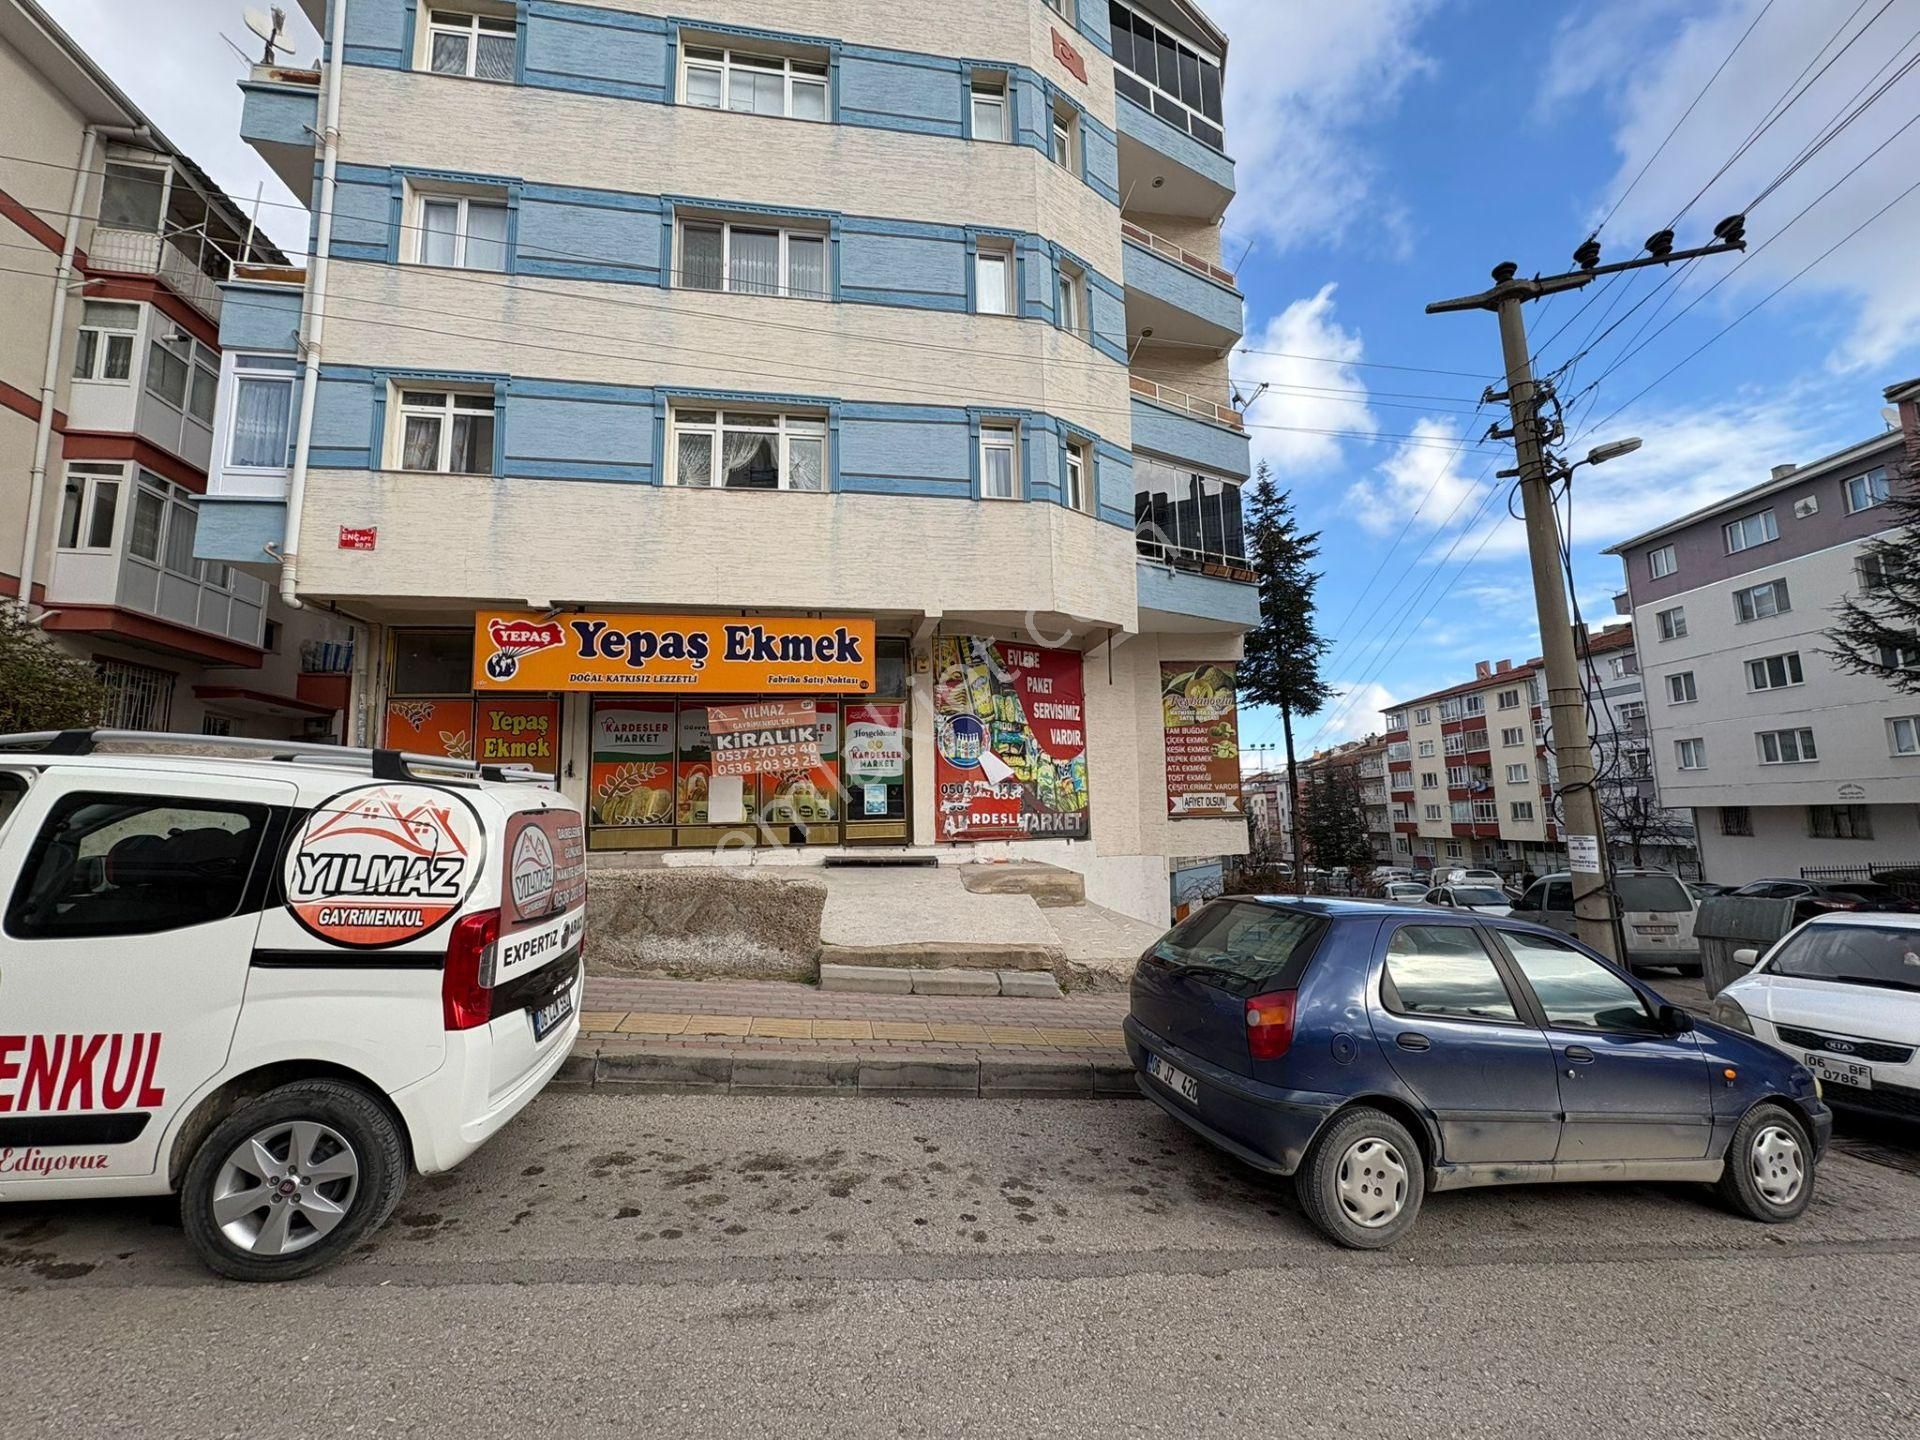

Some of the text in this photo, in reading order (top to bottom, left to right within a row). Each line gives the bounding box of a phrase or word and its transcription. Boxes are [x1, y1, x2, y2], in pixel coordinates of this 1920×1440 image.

[499, 630, 551, 645] YEPAŞ
[570, 620, 863, 669] Yepaş Ekmek
[569, 673, 604, 683] DOĞAL
[606, 674, 650, 683] KATKISIZ
[767, 675, 801, 684] Fabrika
[803, 675, 824, 686] Satış
[826, 676, 859, 685] Noktası
[1026, 676, 1053, 694] PAKET
[741, 704, 785, 719] YILMAZ
[1033, 699, 1081, 722] SERVİSİMİZ
[488, 710, 549, 735] Yepaş
[1181, 726, 1208, 734] BUĞDAY
[614, 734, 660, 743] MARKET
[1050, 728, 1084, 747] VARDIR.
[483, 737, 550, 758] Ekmek
[716, 743, 817, 762] 0537 270 26 40
[717, 755, 819, 775] 0536 203 92 25
[860, 760, 895, 768] MARKET
[1167, 755, 1189, 763] KEPEK
[1168, 774, 1185, 782] TOST
[1205, 796, 1226, 807] OLSUN
[296, 852, 465, 898] YILMAZ
[515, 866, 552, 901] YILMAZ
[1829, 1042, 1849, 1051] KIA
[1808, 1056, 1826, 1068] 06
[1152, 1055, 1198, 1101] 06 JZ 420
[1823, 1070, 1859, 1086] 0786
[0, 1147, 110, 1176] Ediyoruz
